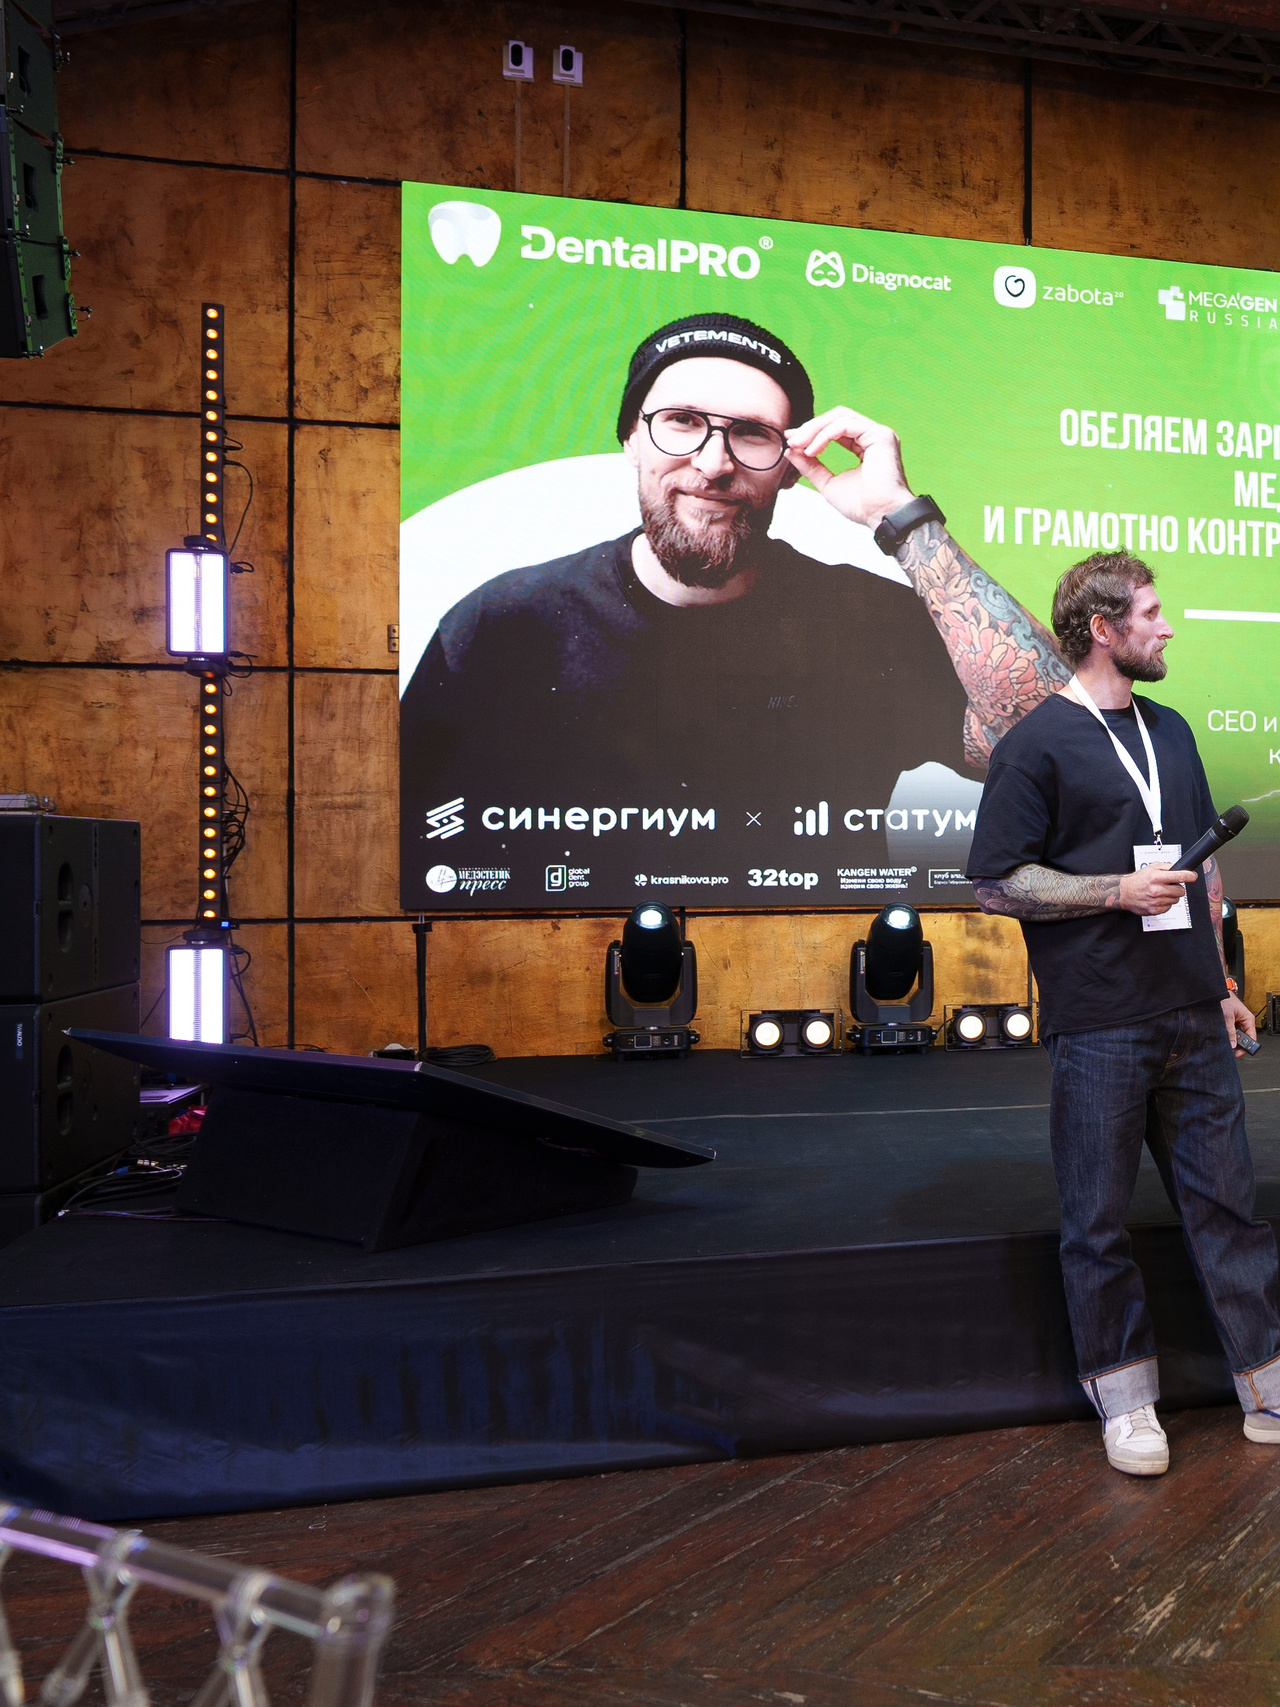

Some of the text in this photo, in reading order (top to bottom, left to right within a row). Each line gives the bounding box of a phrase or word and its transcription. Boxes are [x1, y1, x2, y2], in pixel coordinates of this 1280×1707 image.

[852, 262, 952, 292] Diagnocat
[1042, 283, 1114, 306] zabota
[1189, 309, 1278, 331] RUSSIA
[655, 329, 782, 365] VETEMENTS
[1059, 408, 1208, 456] ОБЕЛЯЕМ
[983, 504, 1005, 544] И
[1014, 506, 1179, 553] ГРАМОТНО
[1207, 709, 1257, 733] CEO
[1263, 716, 1278, 732] и
[481, 806, 716, 837] синергиум
[843, 807, 977, 838] статум
[568, 867, 591, 876] global
[650, 874, 729, 887] krasnikova.pro
[747, 868, 819, 891] 32top
[836, 868, 877, 877] KANGEN
[459, 878, 508, 897] пресс
[568, 880, 590, 888] group
